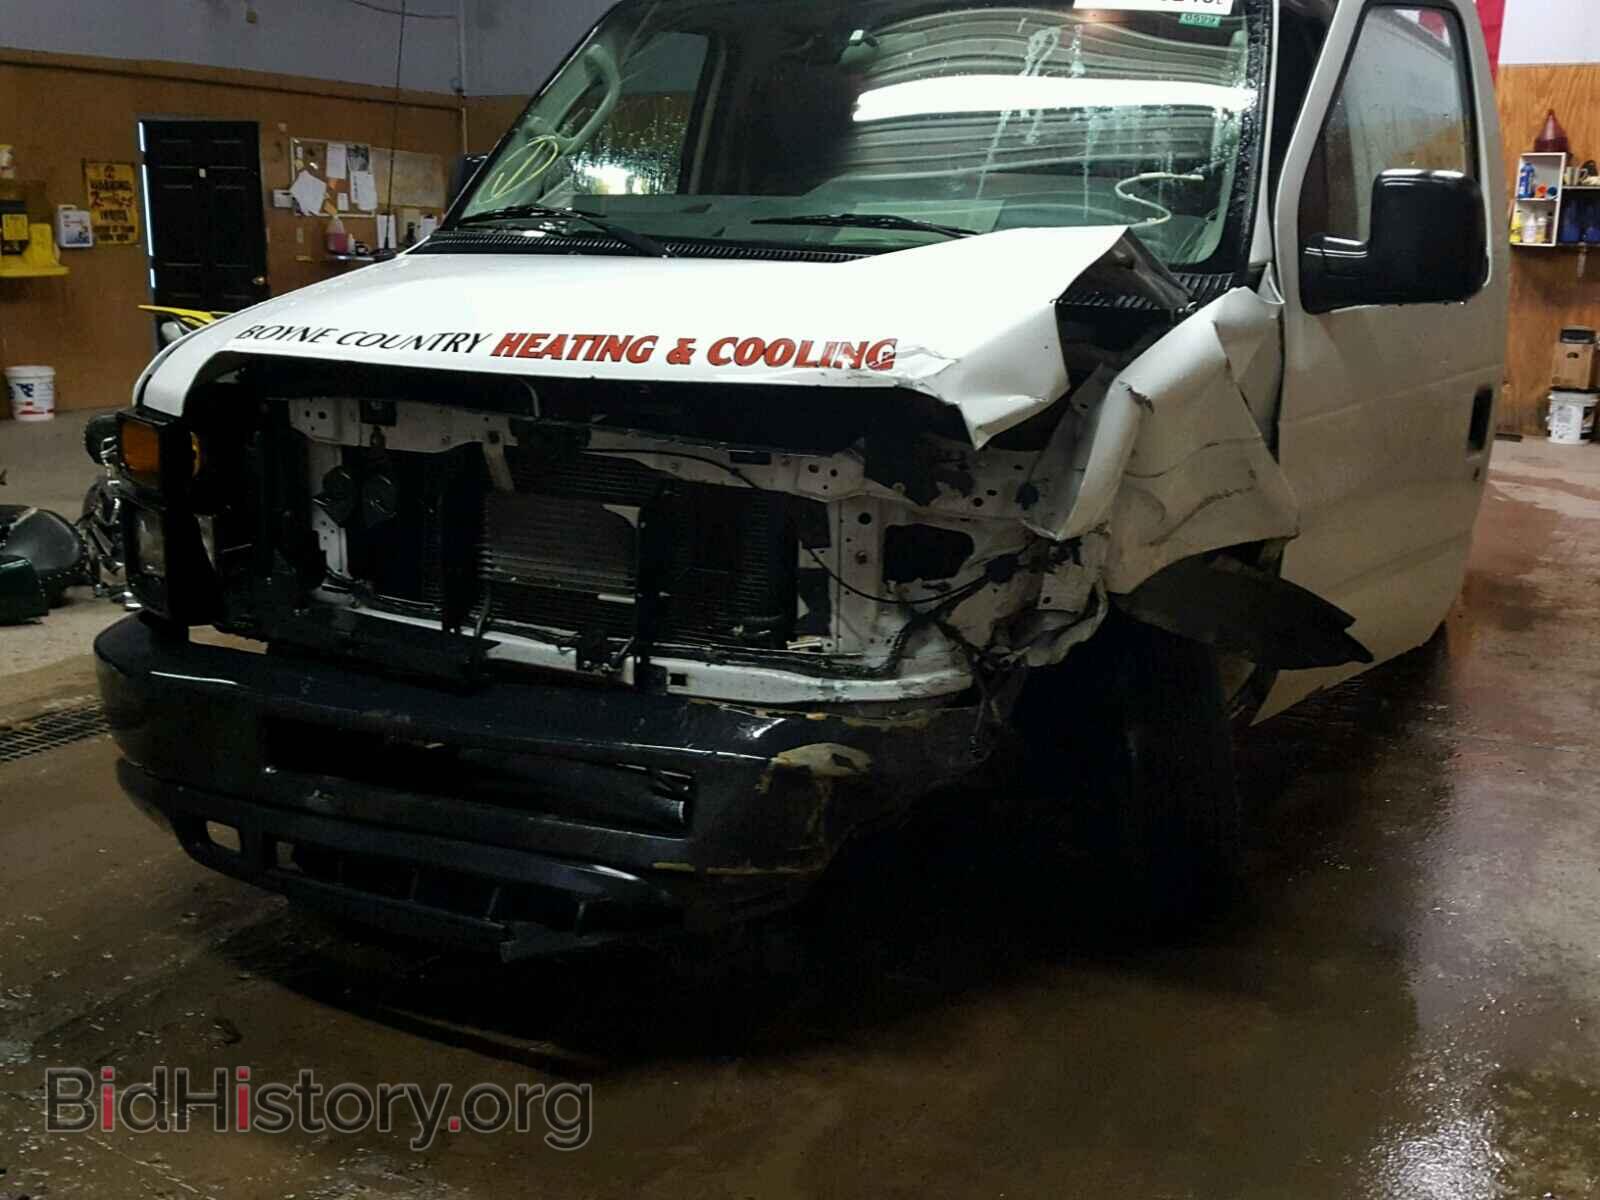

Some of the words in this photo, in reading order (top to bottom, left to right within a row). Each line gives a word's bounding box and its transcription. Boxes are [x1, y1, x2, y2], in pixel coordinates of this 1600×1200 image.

[235, 324, 338, 344] BOYNE
[335, 330, 493, 354] COUNTRY
[489, 332, 660, 365] HEATING
[665, 337, 697, 366] &
[706, 336, 898, 371] COOLING
